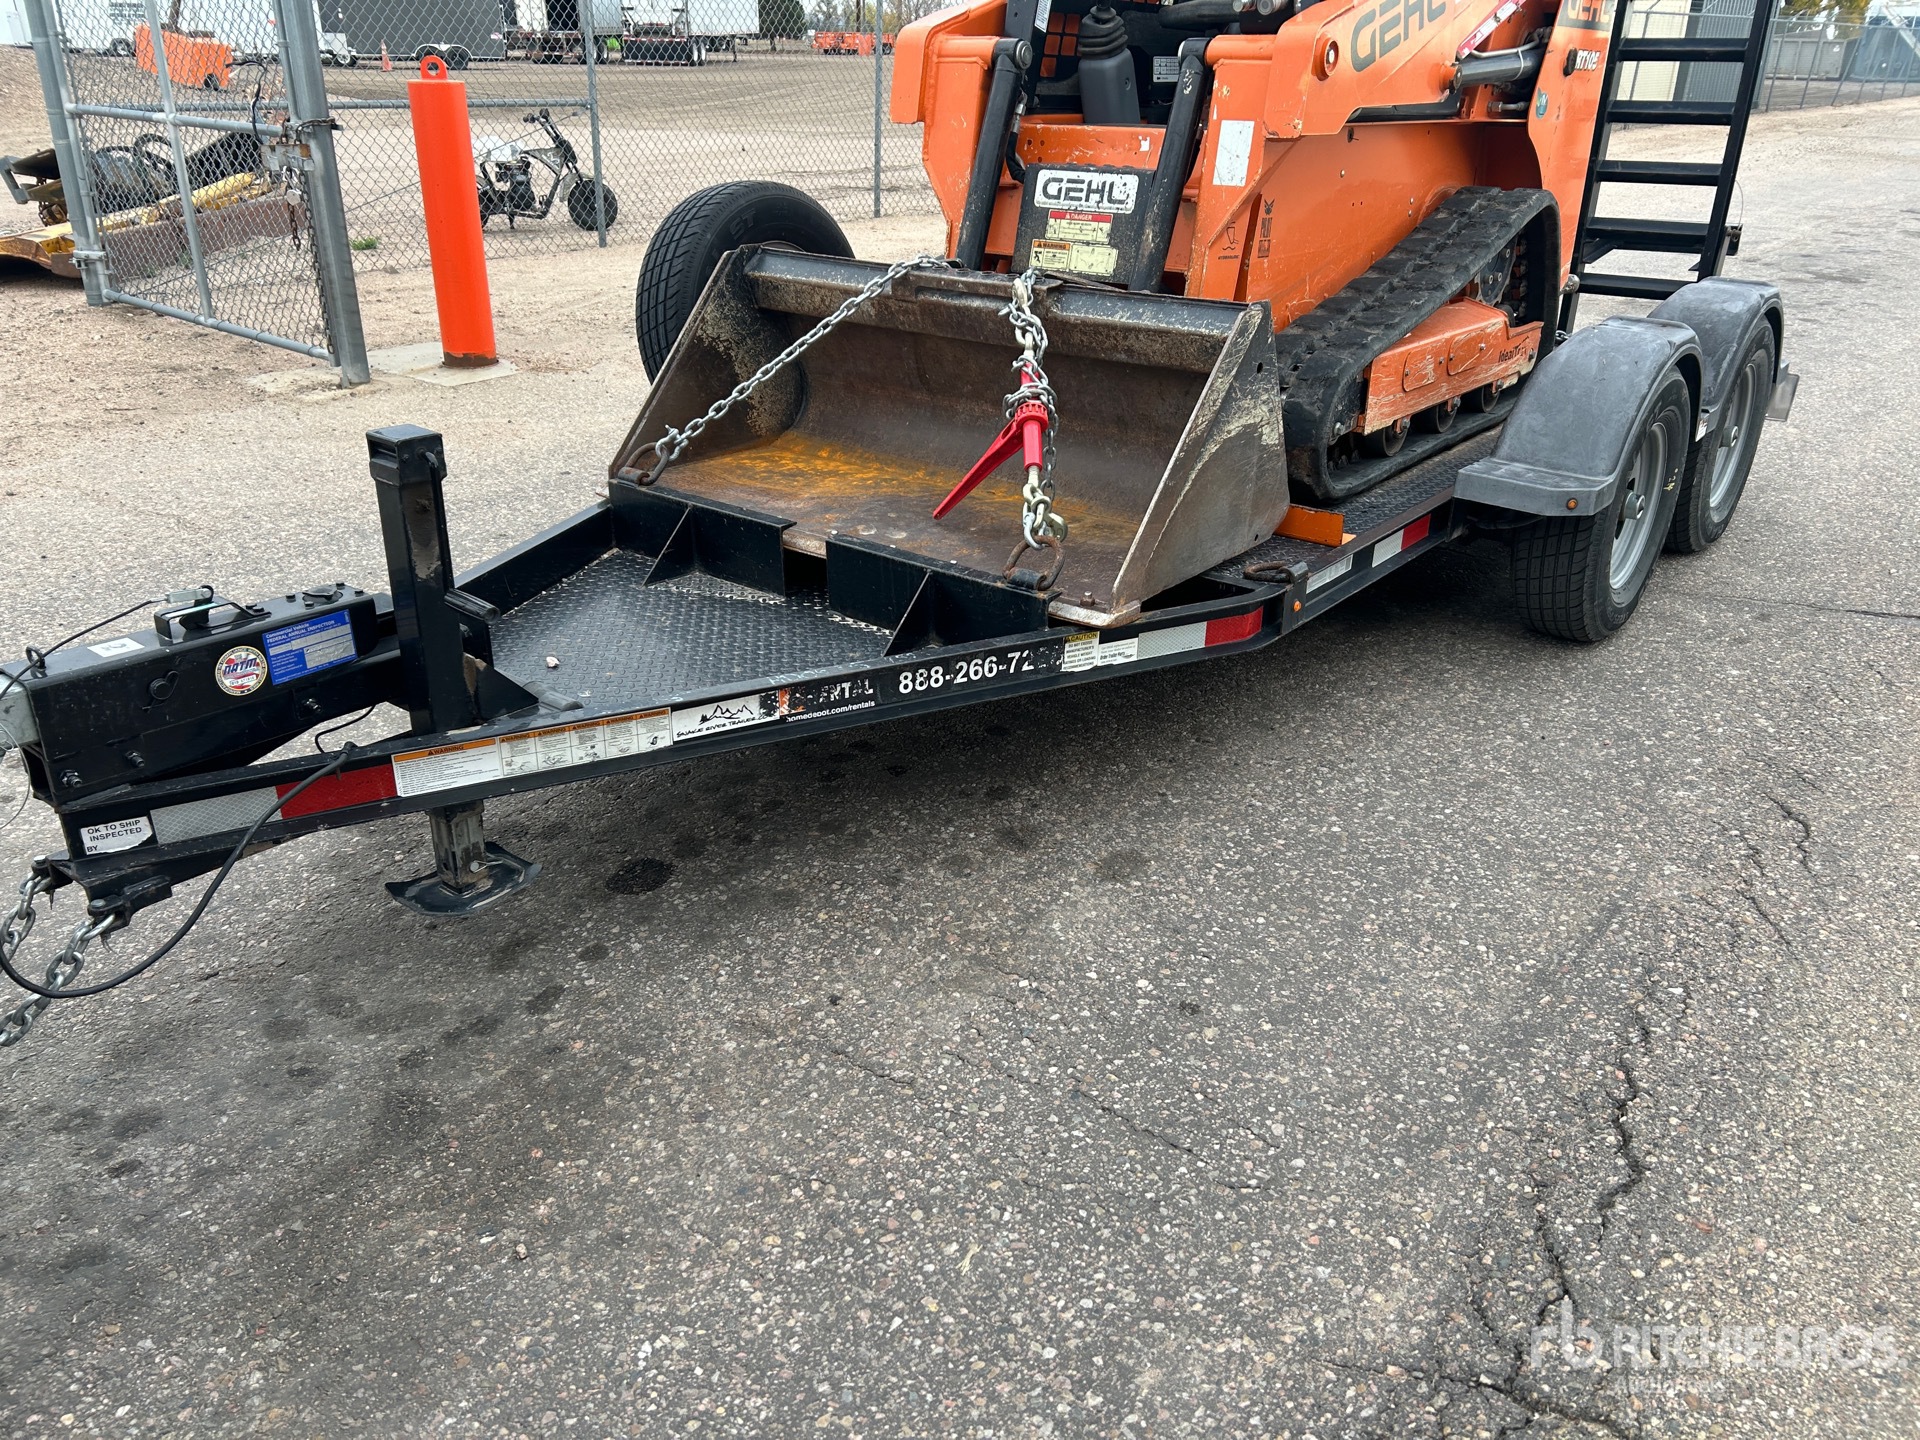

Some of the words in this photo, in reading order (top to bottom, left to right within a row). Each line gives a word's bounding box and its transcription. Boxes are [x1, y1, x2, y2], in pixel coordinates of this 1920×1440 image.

[1575, 49, 1601, 70] RT105
[1042, 177, 1130, 205] GEHL
[267, 635, 288, 644] FEDERAL
[288, 629, 307, 638] ANNUAL
[307, 620, 335, 633] INSPECTION
[1070, 632, 1098, 642] CAUTION
[677, 727, 704, 738] SNAKE
[705, 721, 727, 732] RIVER
[729, 717, 756, 727] TRAILER
[434, 744, 465, 755] WARNING
[87, 826, 101, 835] OK
[104, 823, 117, 832] TO
[118, 819, 141, 829] SHIP
[89, 826, 142, 842] INSPECTED
[86, 845, 98, 853] BY
